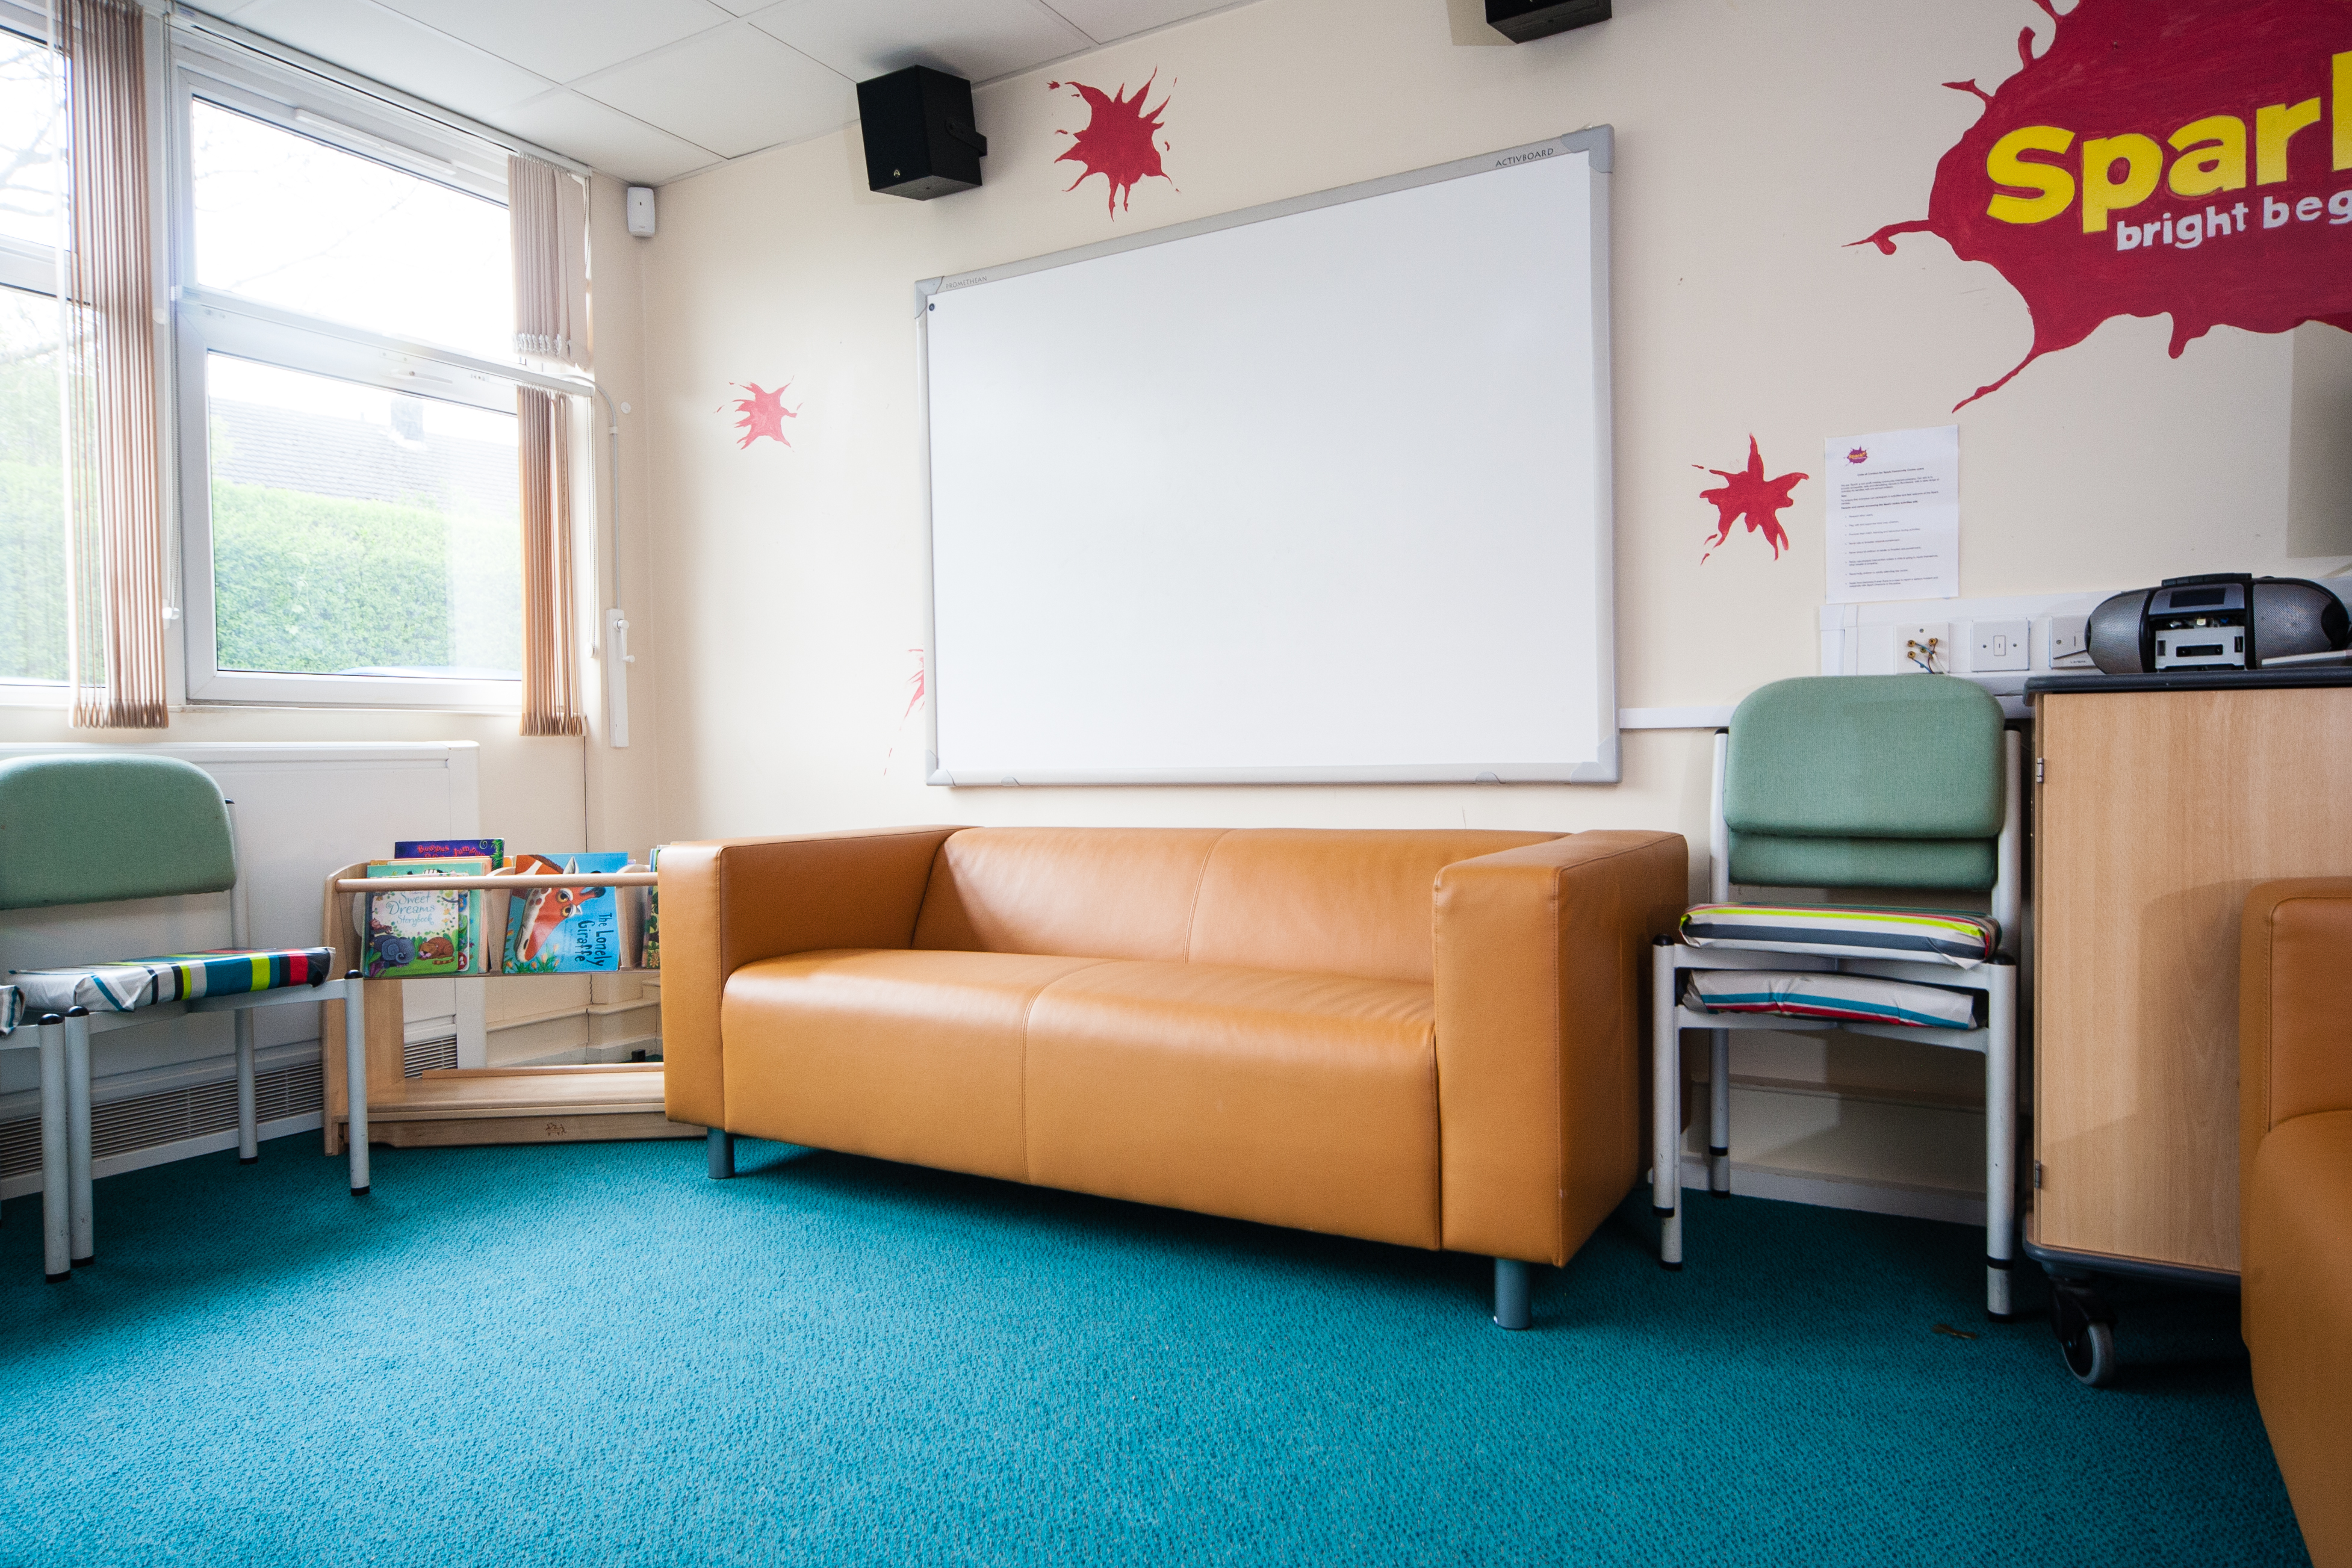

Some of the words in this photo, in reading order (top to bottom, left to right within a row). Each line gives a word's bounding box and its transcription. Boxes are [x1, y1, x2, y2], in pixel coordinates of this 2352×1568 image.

[1986, 51, 2352, 234] Spar
[1495, 147, 1553, 167] ACTIVBOARD
[2117, 202, 2248, 251] bright
[946, 276, 987, 289] PROMETHEAN
[399, 892, 430, 904] Sweet
[386, 900, 435, 915] Dreams
[397, 914, 434, 927] Storybook
[598, 913, 612, 926] The
[575, 920, 595, 962] Giraffe
[586, 930, 614, 966] Lonely
